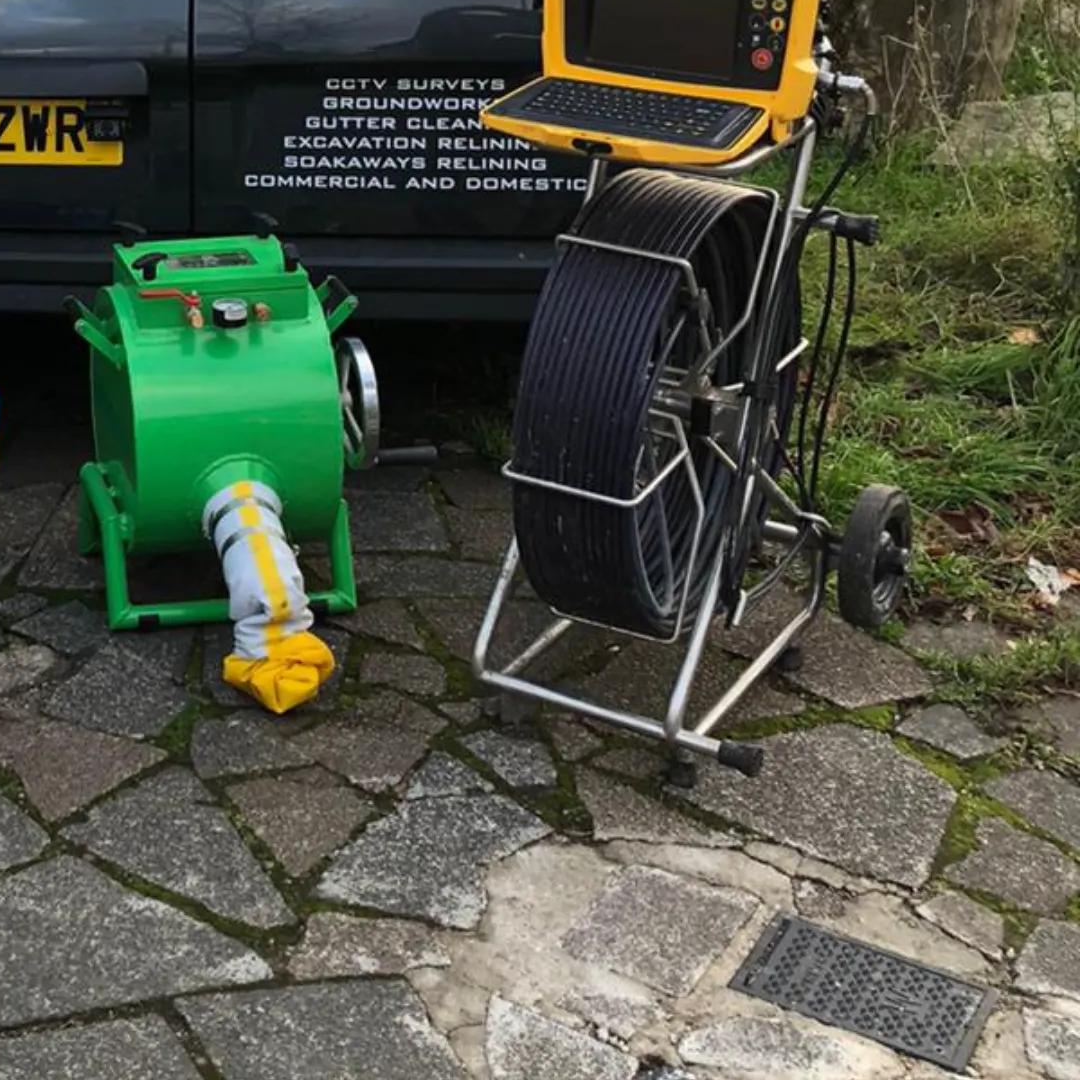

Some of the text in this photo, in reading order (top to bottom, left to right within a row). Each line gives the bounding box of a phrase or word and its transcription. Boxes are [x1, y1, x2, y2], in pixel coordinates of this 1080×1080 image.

[326, 78, 505, 91] CCTV SURVEYS
[323, 97, 494, 111] GROUNDWORK
[305, 116, 486, 130] GUTTER CLEAN
[284, 136, 427, 150] EXCAVATION
[284, 156, 547, 171] SOAKAWAYS RELINING
[244, 175, 588, 191] COMMERCIAL AND DOMESTIC
